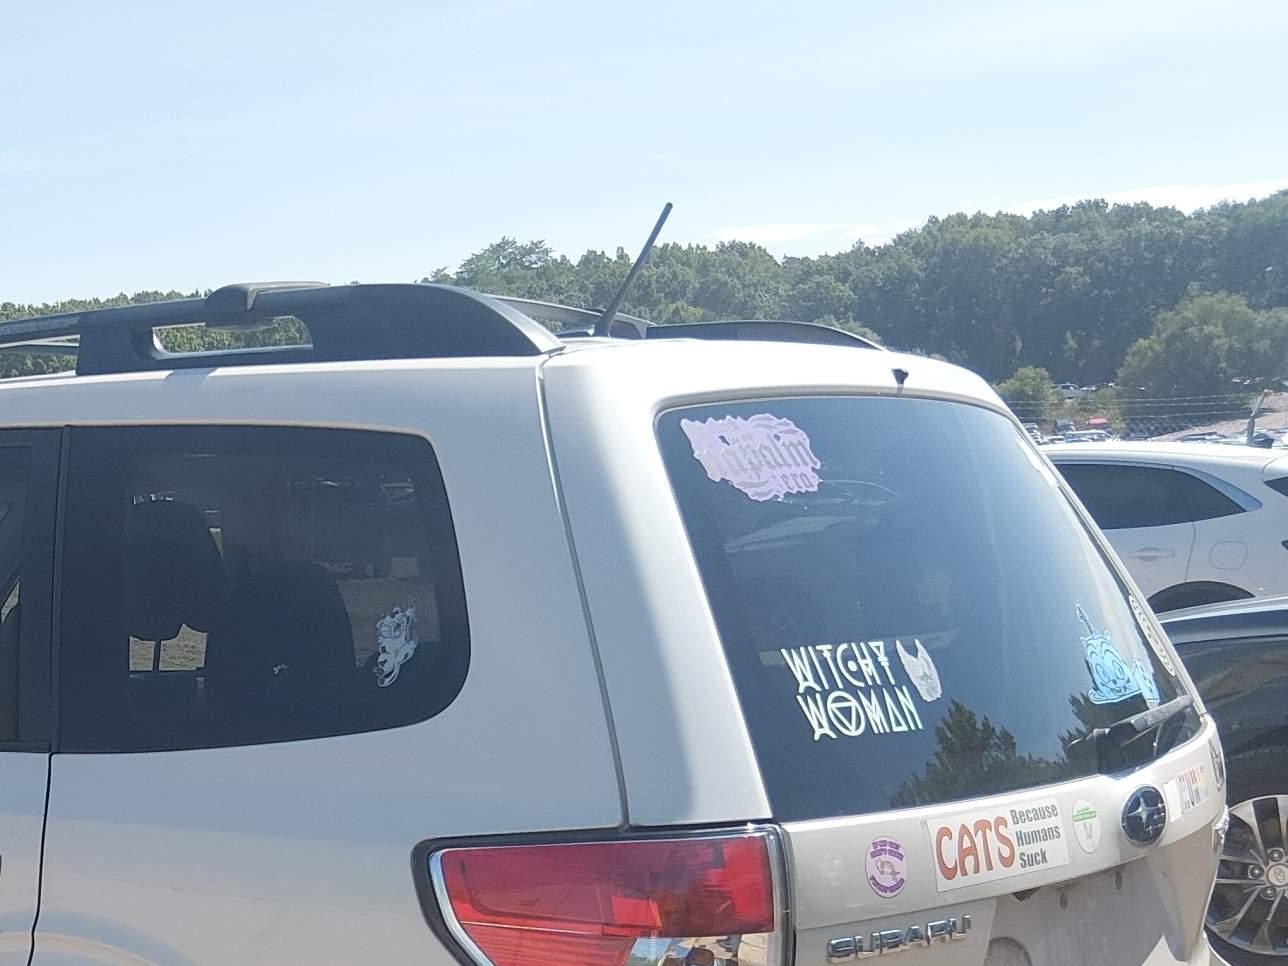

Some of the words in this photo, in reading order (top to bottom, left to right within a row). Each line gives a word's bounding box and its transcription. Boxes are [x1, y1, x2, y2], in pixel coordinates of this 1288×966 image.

[781, 641, 896, 693] WITCHY
[797, 685, 924, 741] WOMAN
[1010, 804, 1058, 824] Because
[1016, 825, 1061, 846] Humans
[935, 815, 1016, 880] CATS
[1019, 848, 1048, 868] Suck
[827, 915, 971, 962] SUBARU
